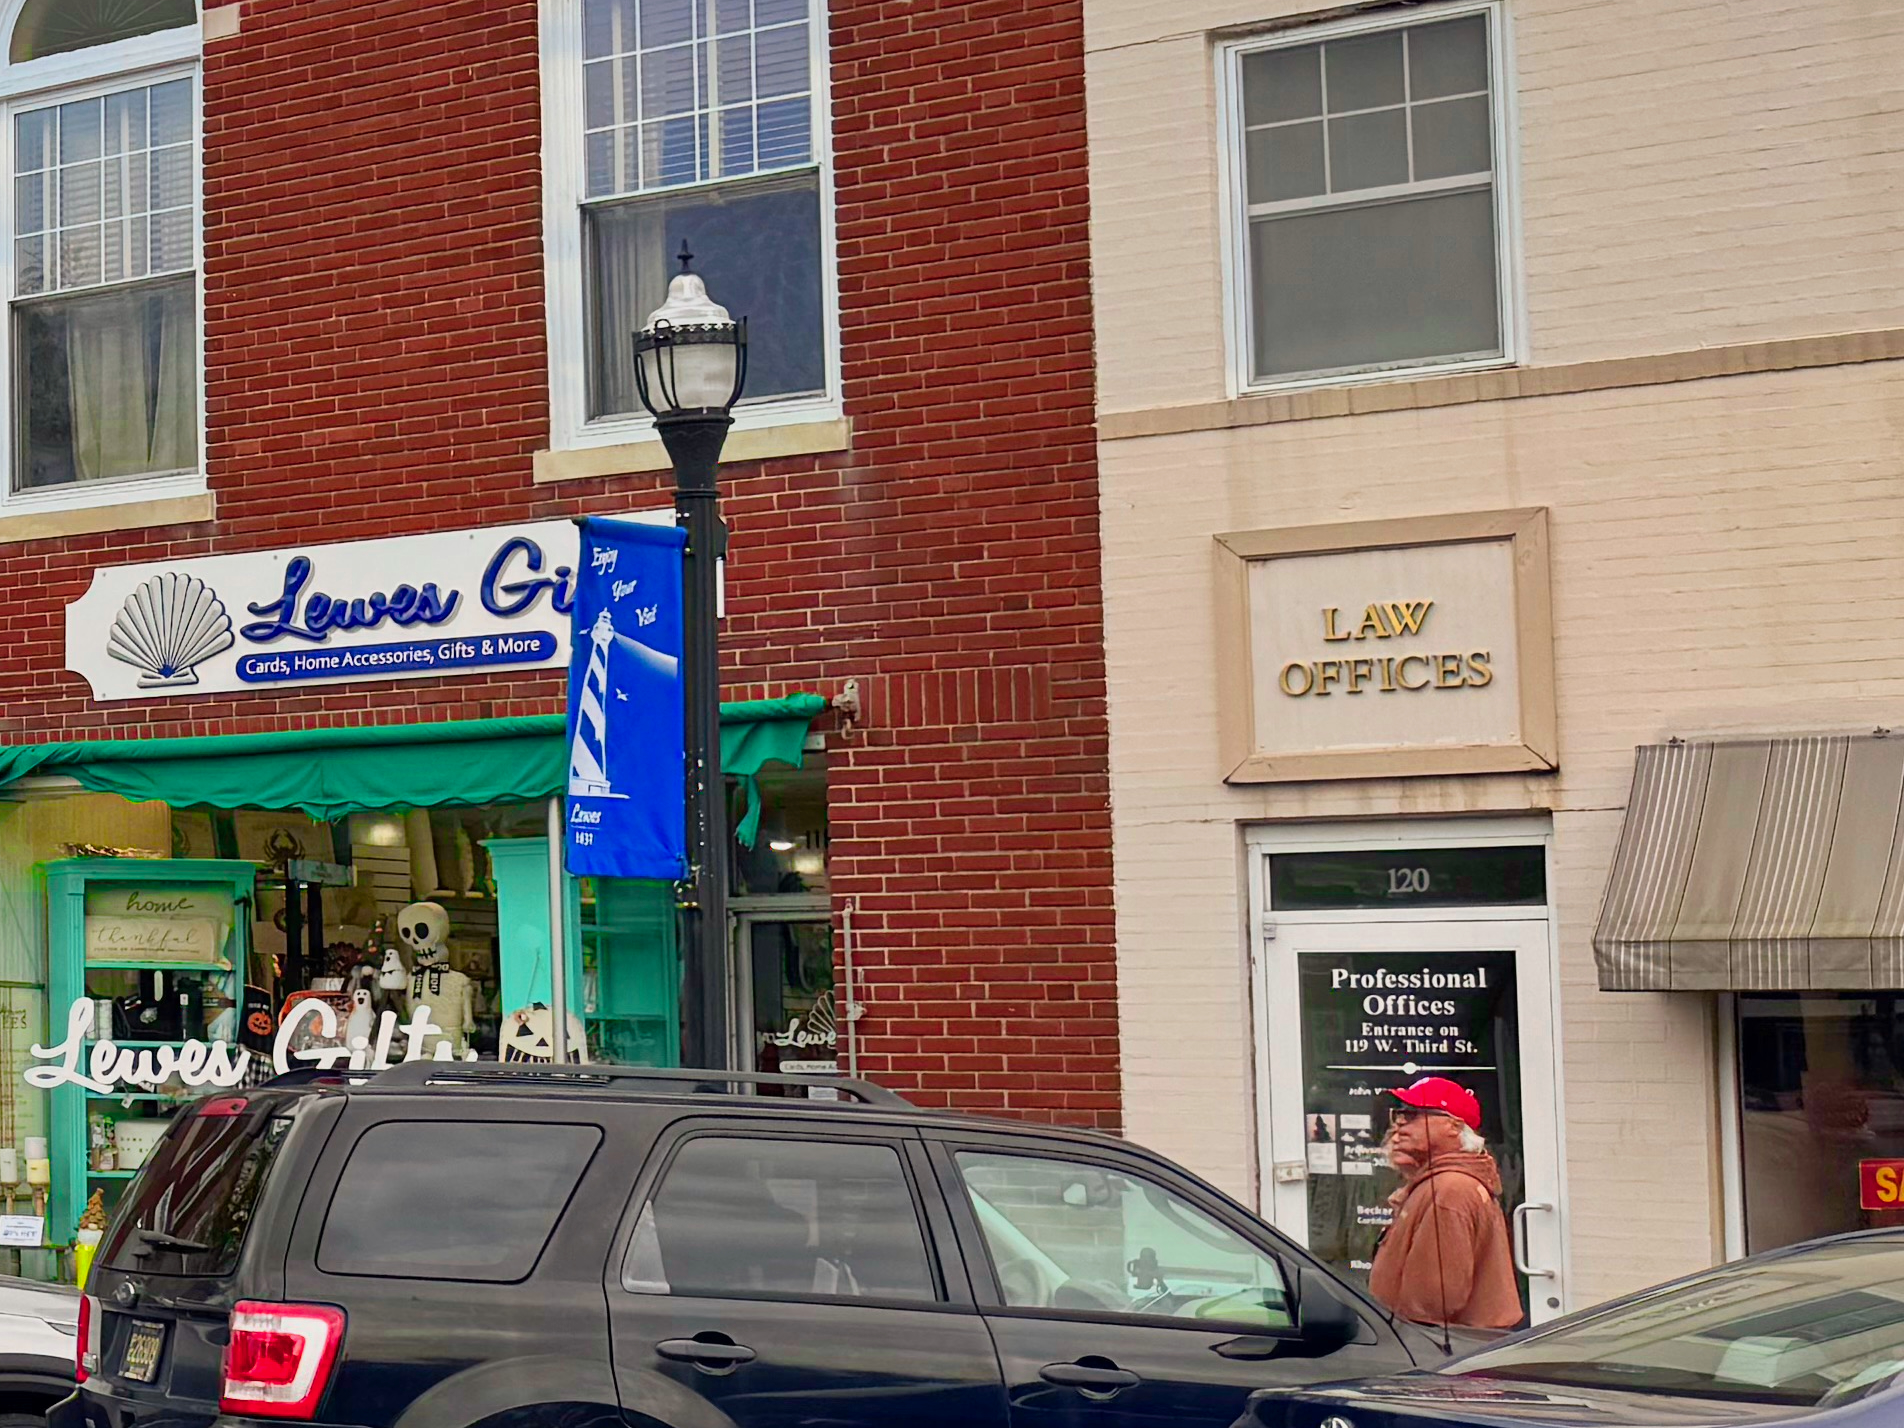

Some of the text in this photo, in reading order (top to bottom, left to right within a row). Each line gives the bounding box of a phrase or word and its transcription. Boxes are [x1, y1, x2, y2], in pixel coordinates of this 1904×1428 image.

[591, 546, 618, 576] Enjoy
[240, 556, 460, 642] Lewes
[612, 579, 637, 602] Your
[635, 603, 658, 627] Visit
[1322, 599, 1434, 641] LAW
[245, 638, 541, 675] Cards, Home Accessories, Gifts & More
[1279, 651, 1493, 696] OFFICES
[1387, 868, 1430, 893] 120
[126, 891, 194, 913] home
[1331, 967, 1487, 989] Professional
[1363, 995, 1456, 1015] Offices
[775, 1019, 837, 1047] Lewe
[1361, 1022, 1459, 1036] Entrance on
[23, 996, 249, 1094] Lewes
[1345, 1039, 1478, 1053] 119 W. Third St.
[1876, 1166, 1904, 1202] S
